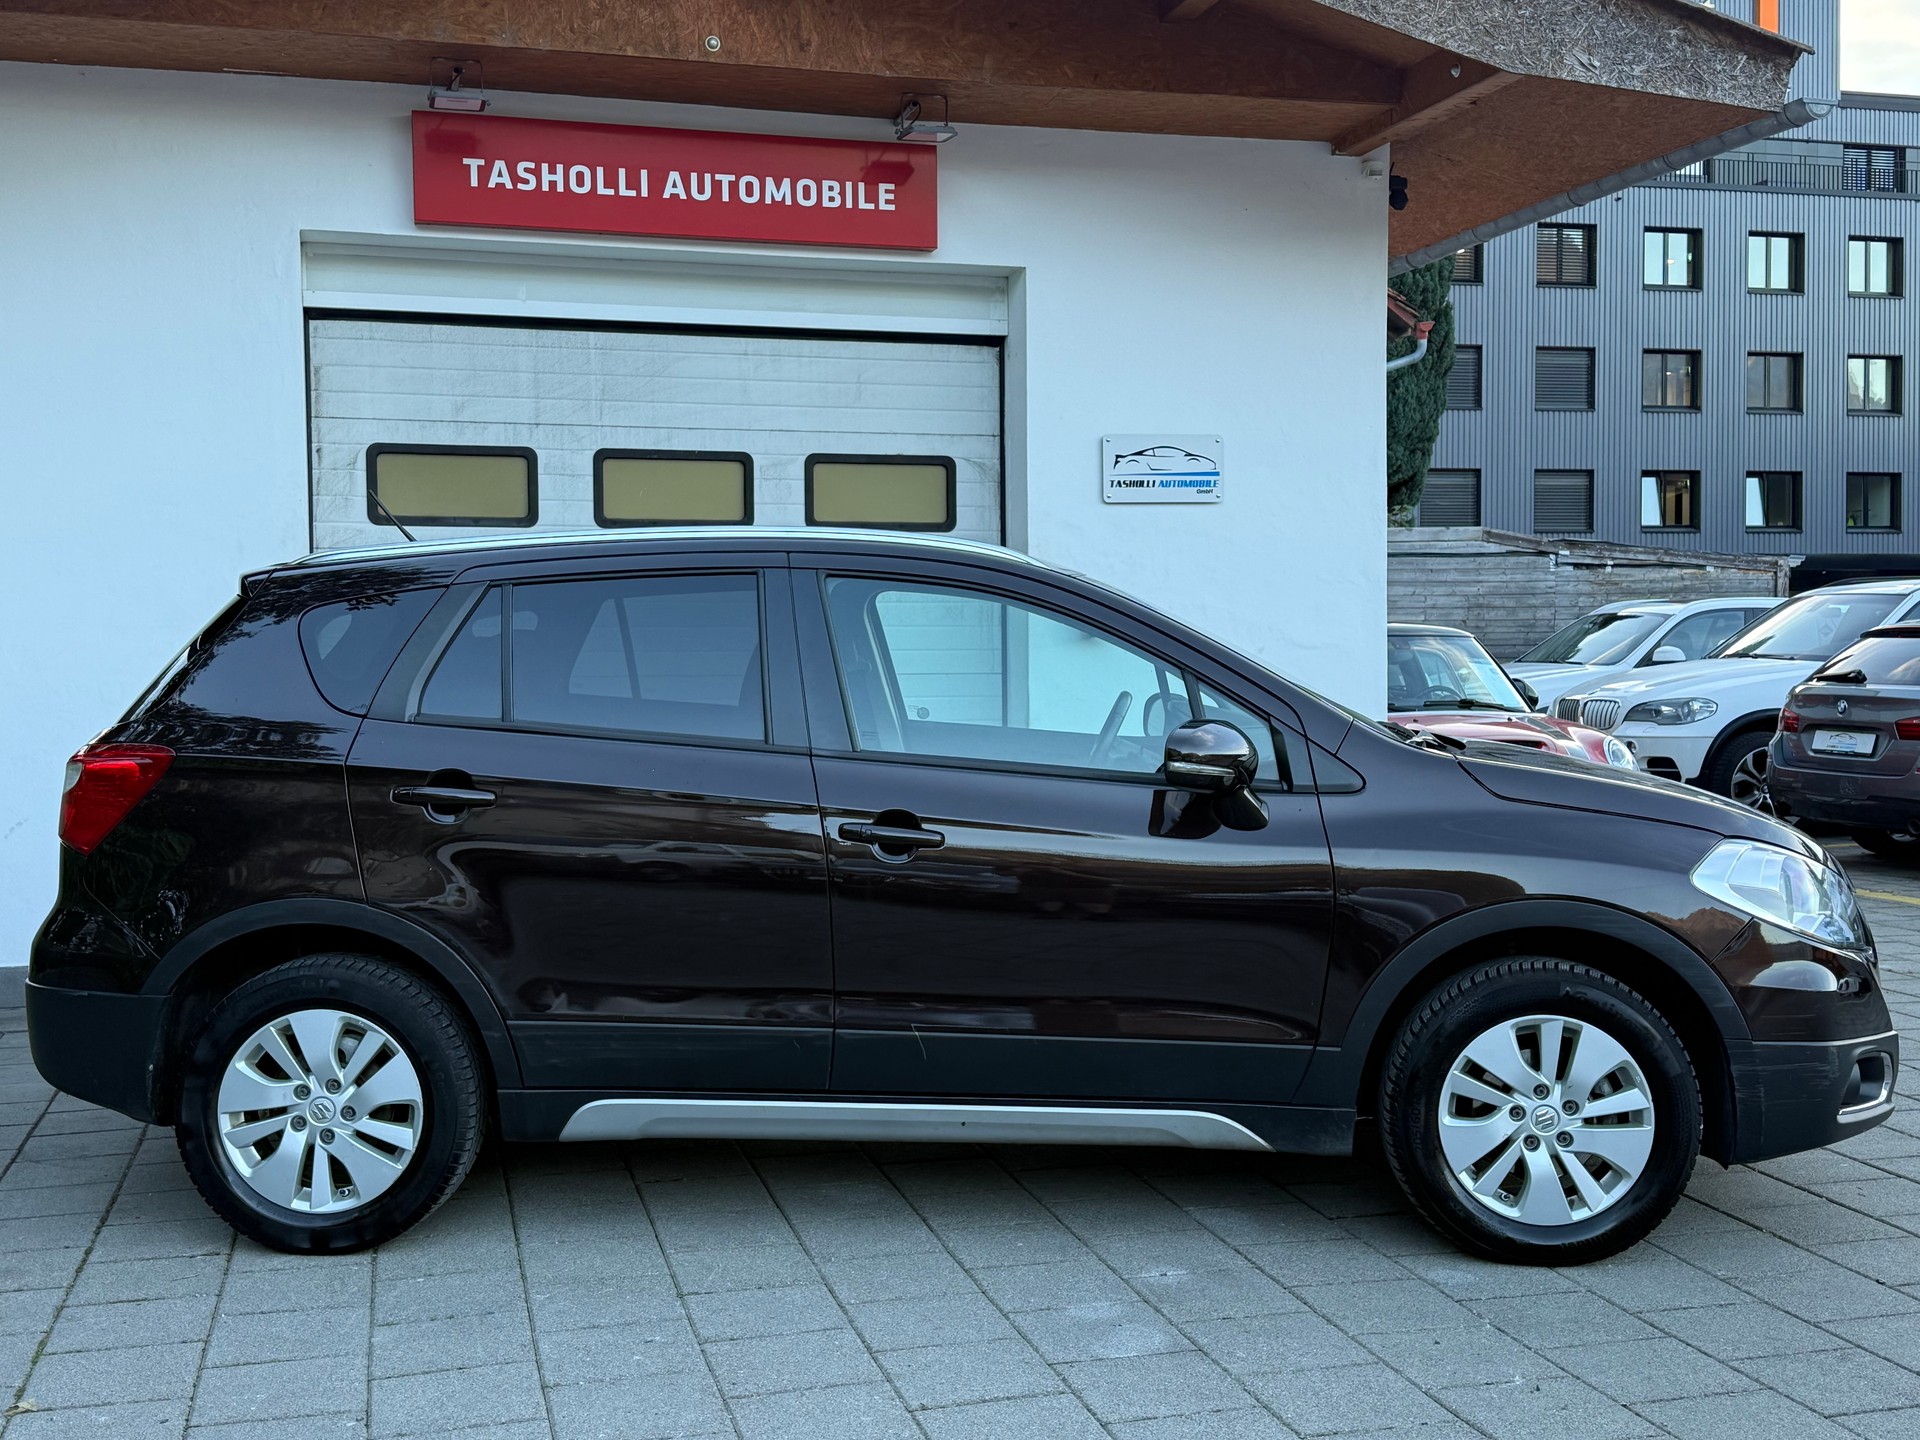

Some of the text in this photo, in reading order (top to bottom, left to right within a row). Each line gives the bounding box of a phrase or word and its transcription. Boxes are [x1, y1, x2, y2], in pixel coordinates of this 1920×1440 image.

[463, 157, 896, 210] TASHOLLI AUTOMOBILE
[1110, 480, 1219, 488] TASHOLLI AUTOMOBILE
